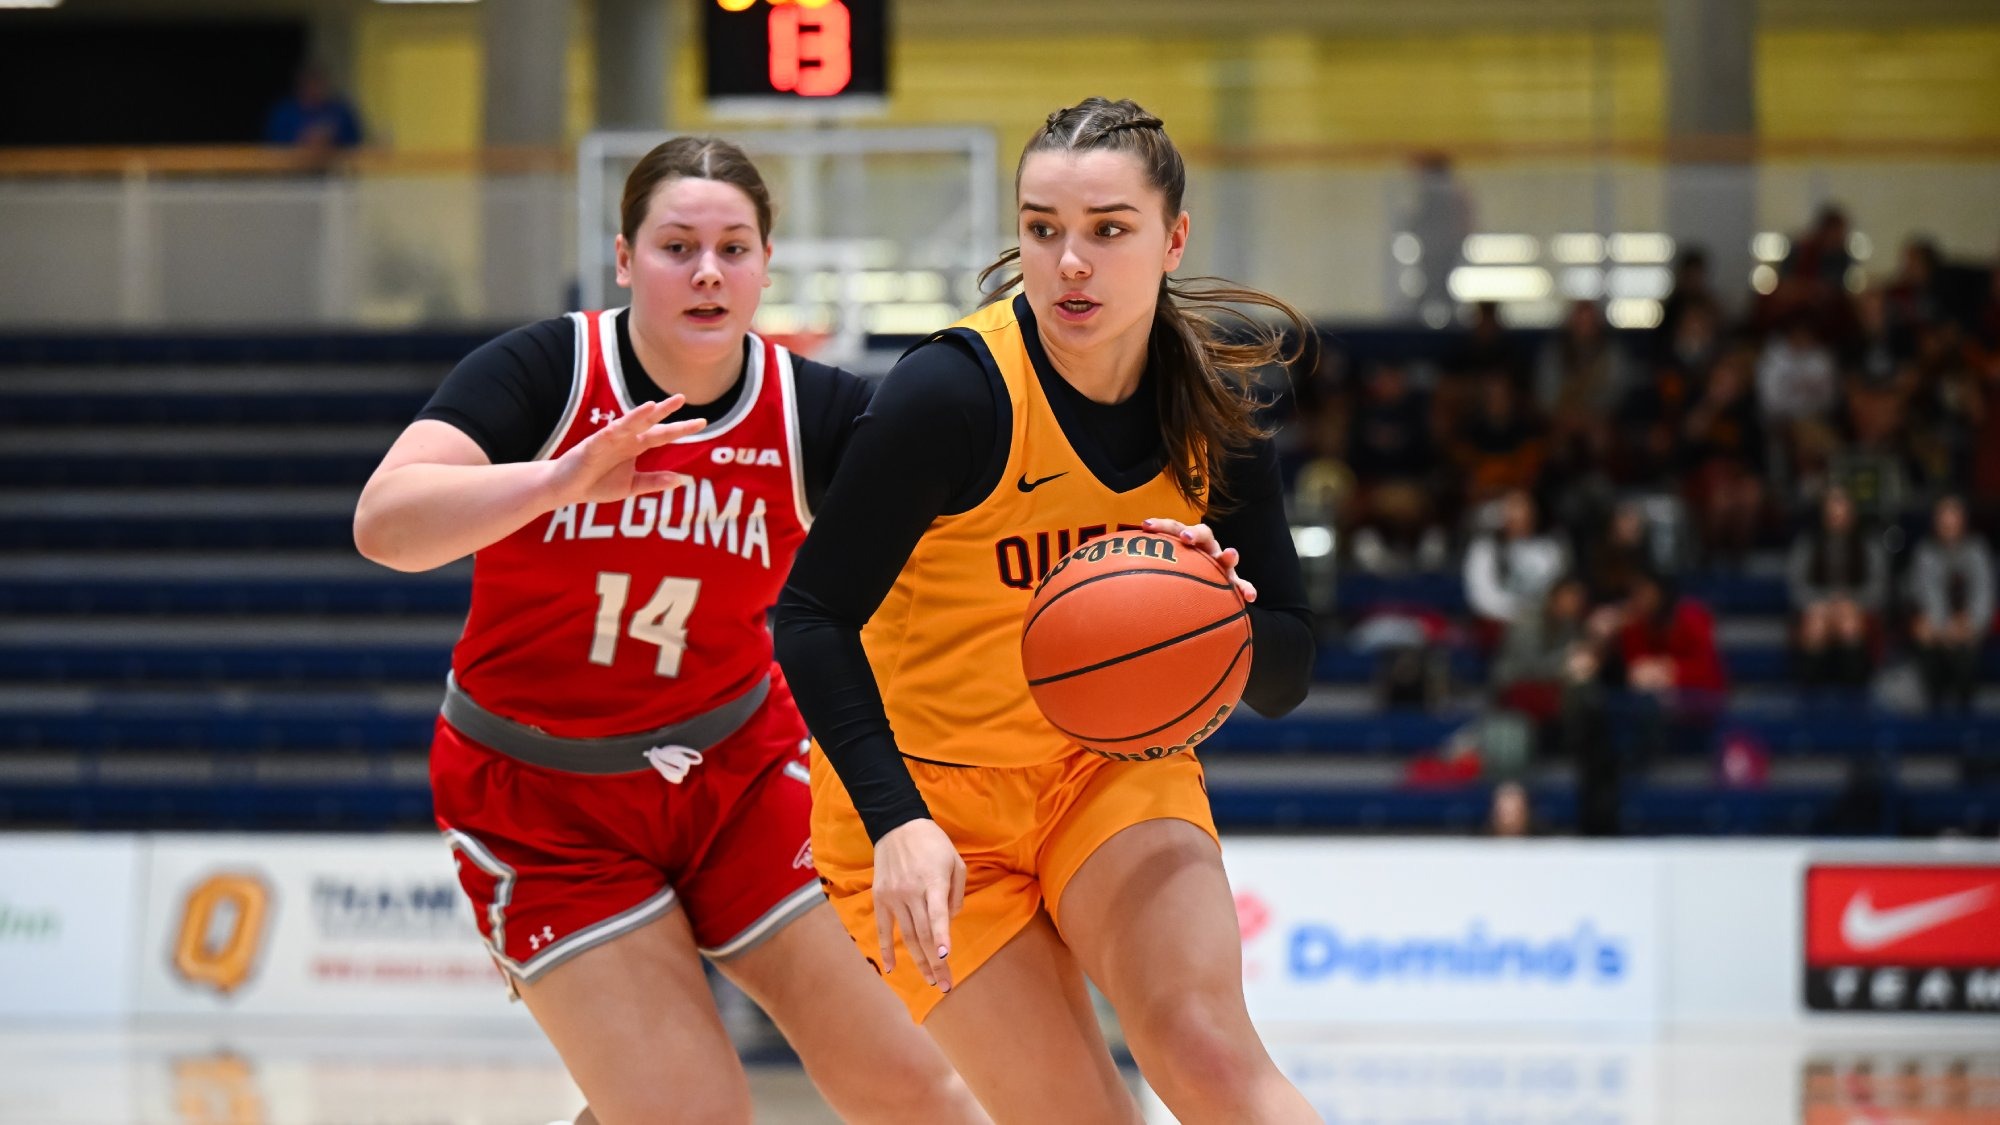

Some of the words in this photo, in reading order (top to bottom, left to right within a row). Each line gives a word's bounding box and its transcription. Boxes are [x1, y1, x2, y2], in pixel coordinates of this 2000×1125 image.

[710, 446, 783, 467] OUA
[588, 571, 702, 679] 14
[1288, 919, 1627, 982] Domino's
